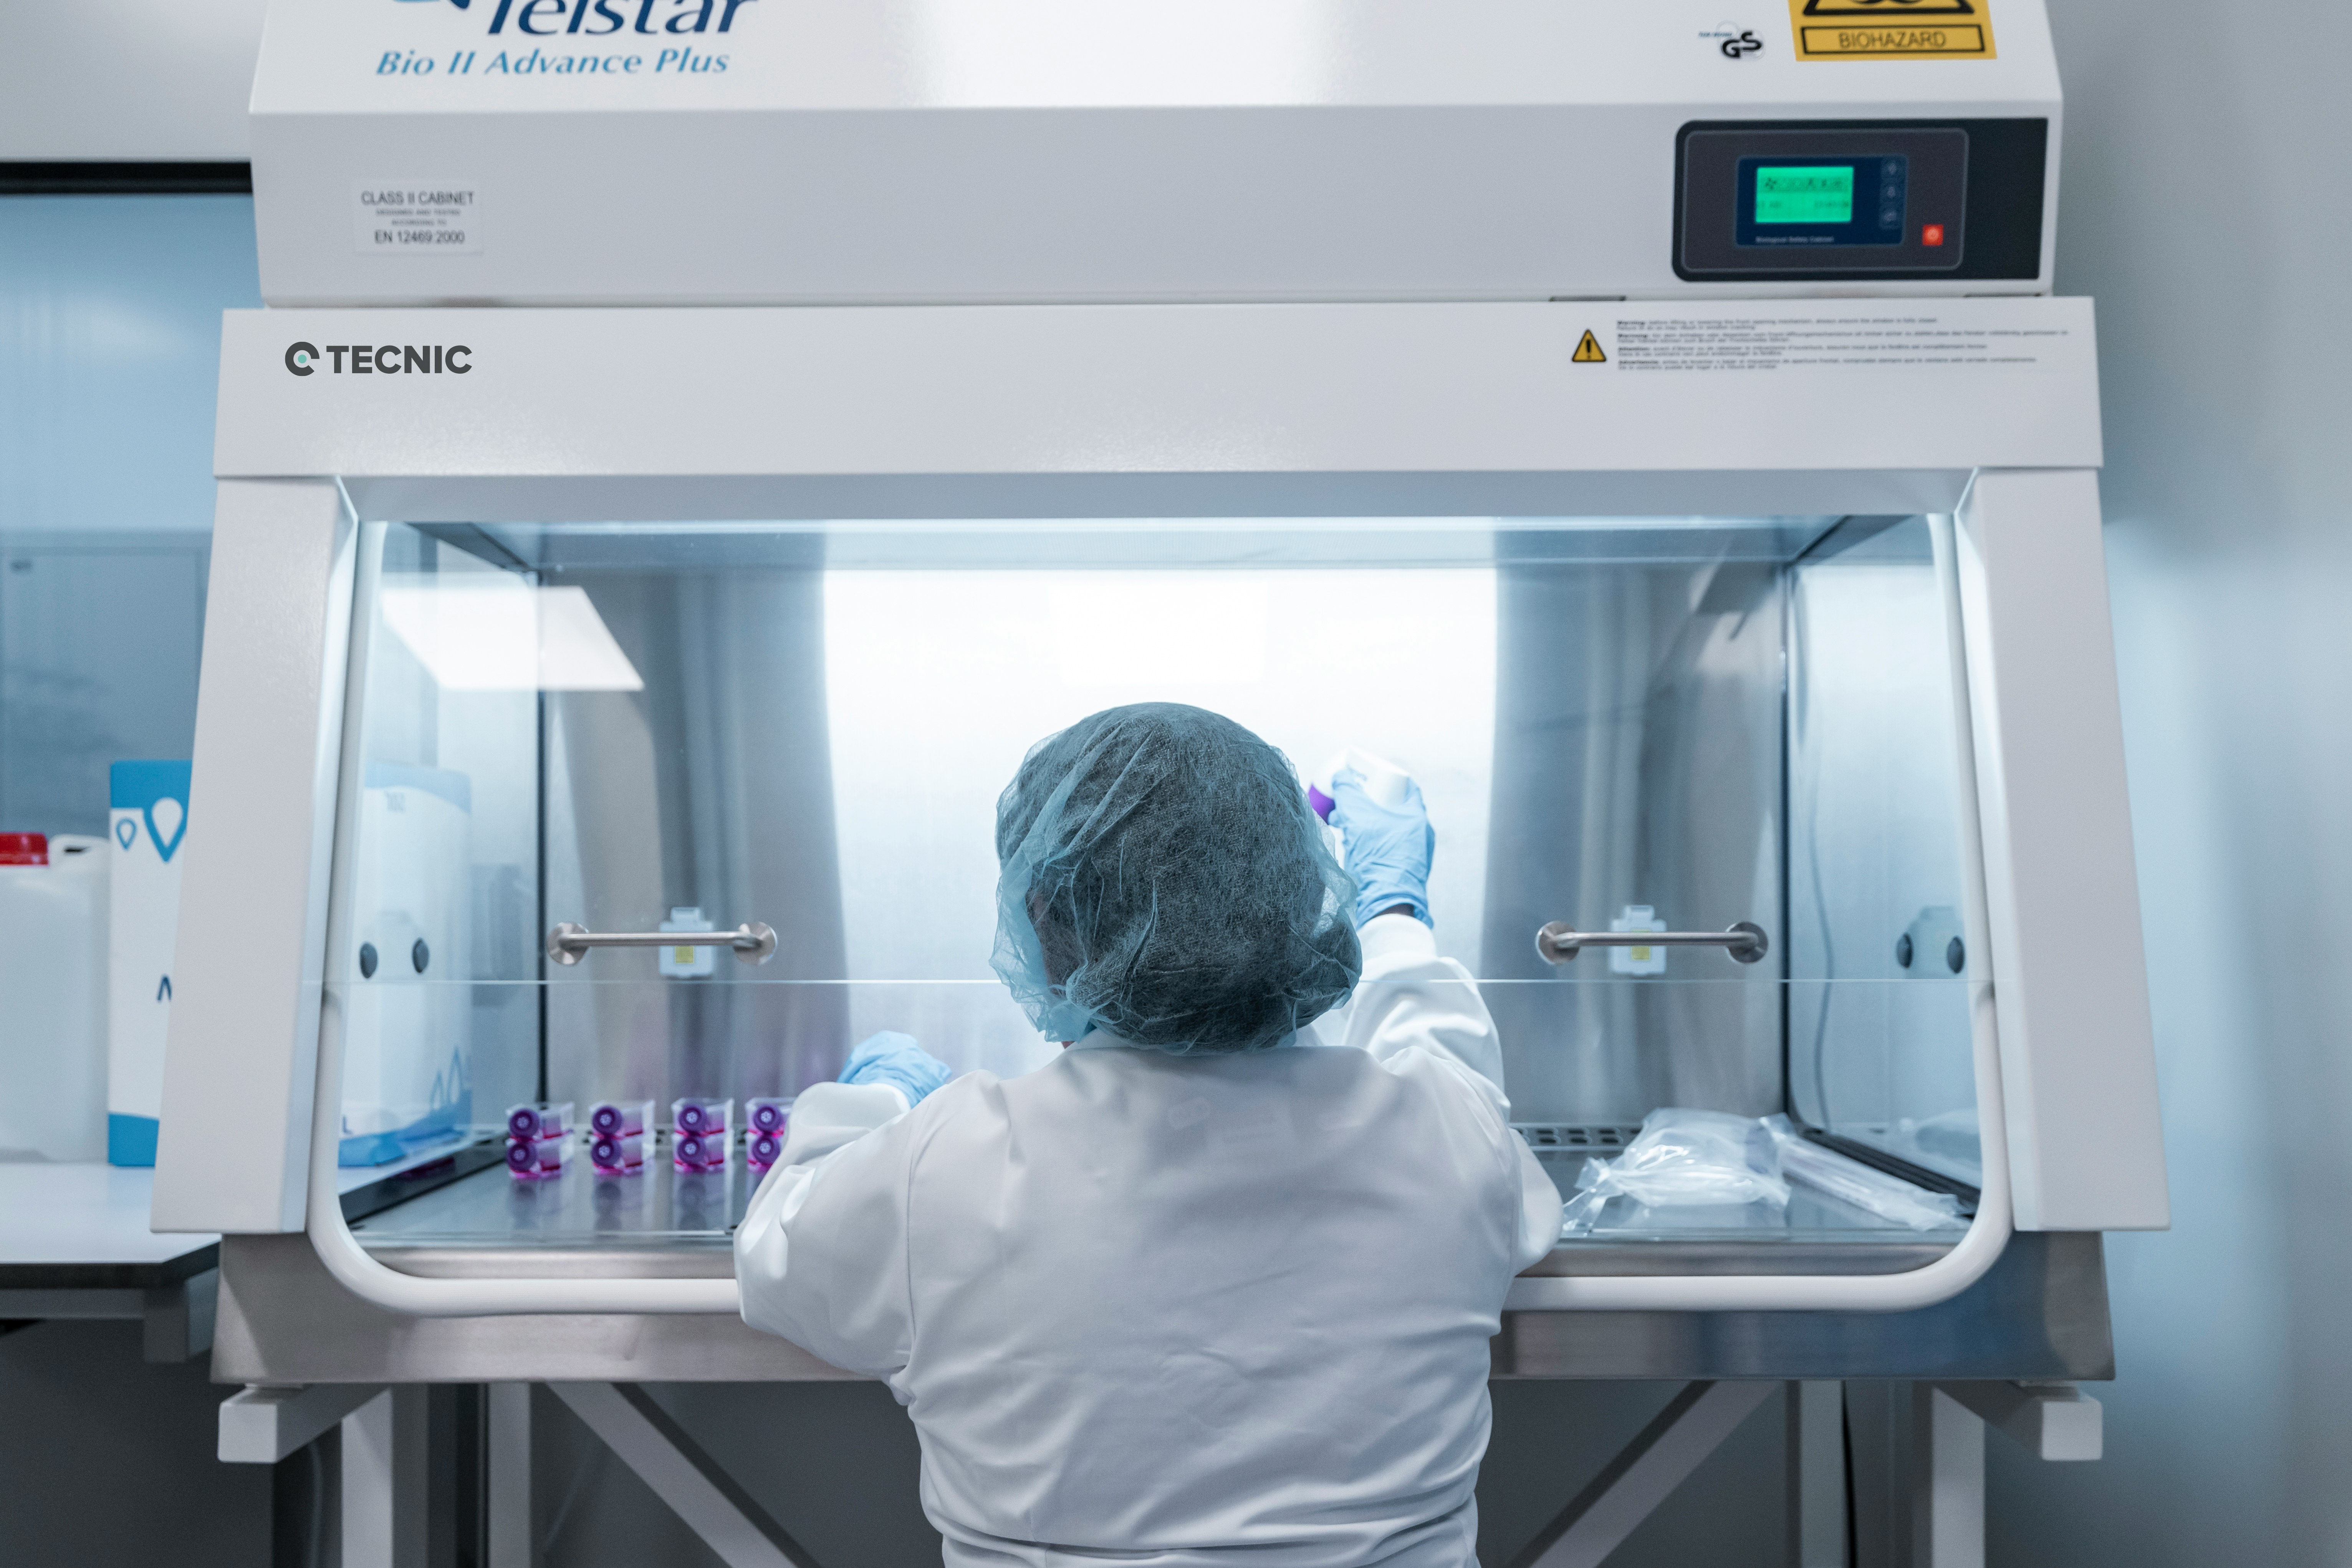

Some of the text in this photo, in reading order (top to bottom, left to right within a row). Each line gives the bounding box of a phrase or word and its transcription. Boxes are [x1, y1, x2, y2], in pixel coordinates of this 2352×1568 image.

[1838, 30, 1947, 49] BIOHAZARD
[377, 46, 729, 75] Bio II Advance Plus
[361, 191, 474, 205] CLASS II CABINET
[374, 229, 392, 243] EN
